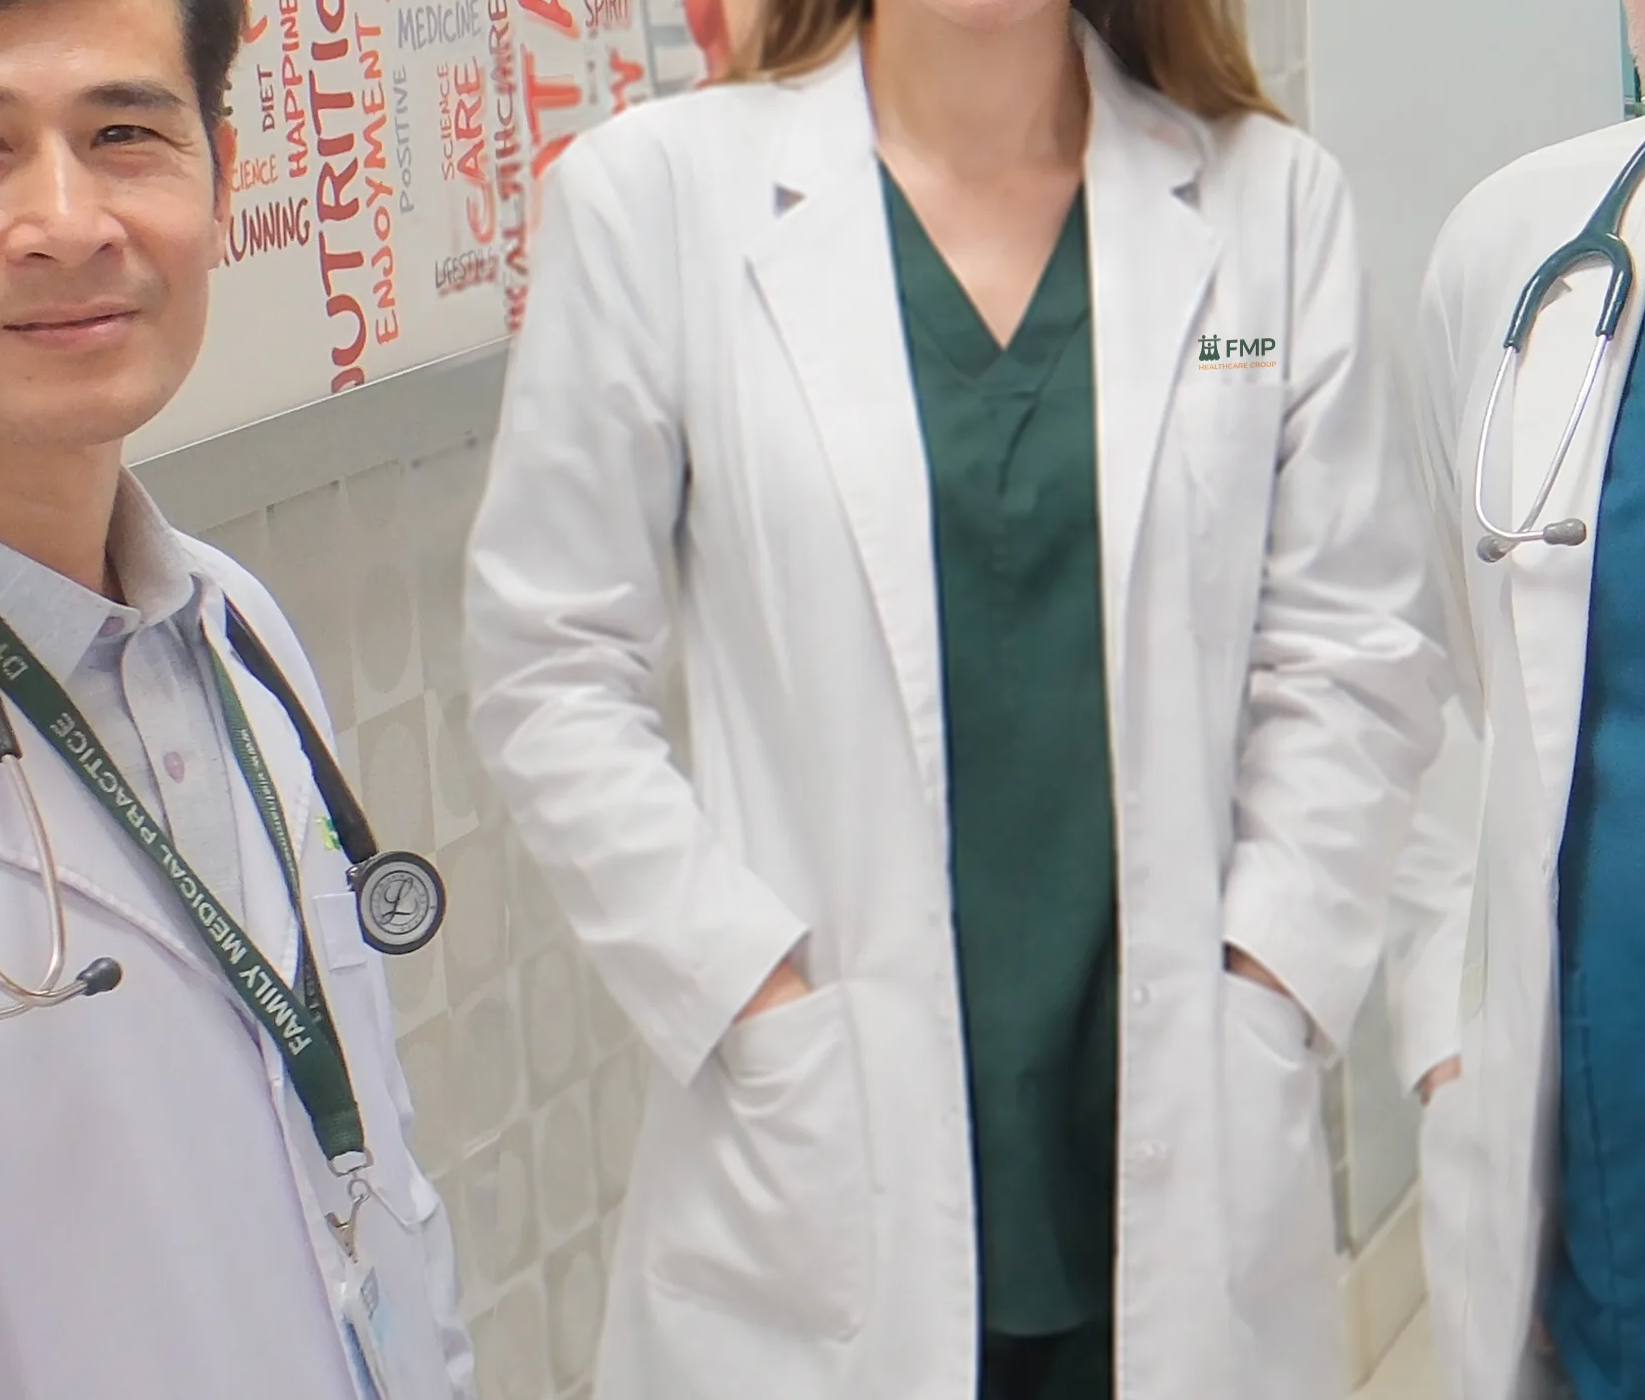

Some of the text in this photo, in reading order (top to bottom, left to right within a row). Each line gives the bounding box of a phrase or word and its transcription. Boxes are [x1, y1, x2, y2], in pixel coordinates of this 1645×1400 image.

[257, 64, 276, 132] DIET
[394, 63, 416, 215] POSITIVE
[436, 61, 455, 181] SCIENCE
[455, 56, 496, 244] CARE
[224, 196, 311, 268] UNNING
[355, 11, 399, 345] ENJOYMENT
[1198, 360, 1277, 371] HEALTHCARE GROUP
[1225, 337, 1276, 358] FMP
[50, 712, 157, 845] PRACTICE
[160, 844, 247, 965] MEDICAL
[240, 965, 313, 1056] FAMILY
